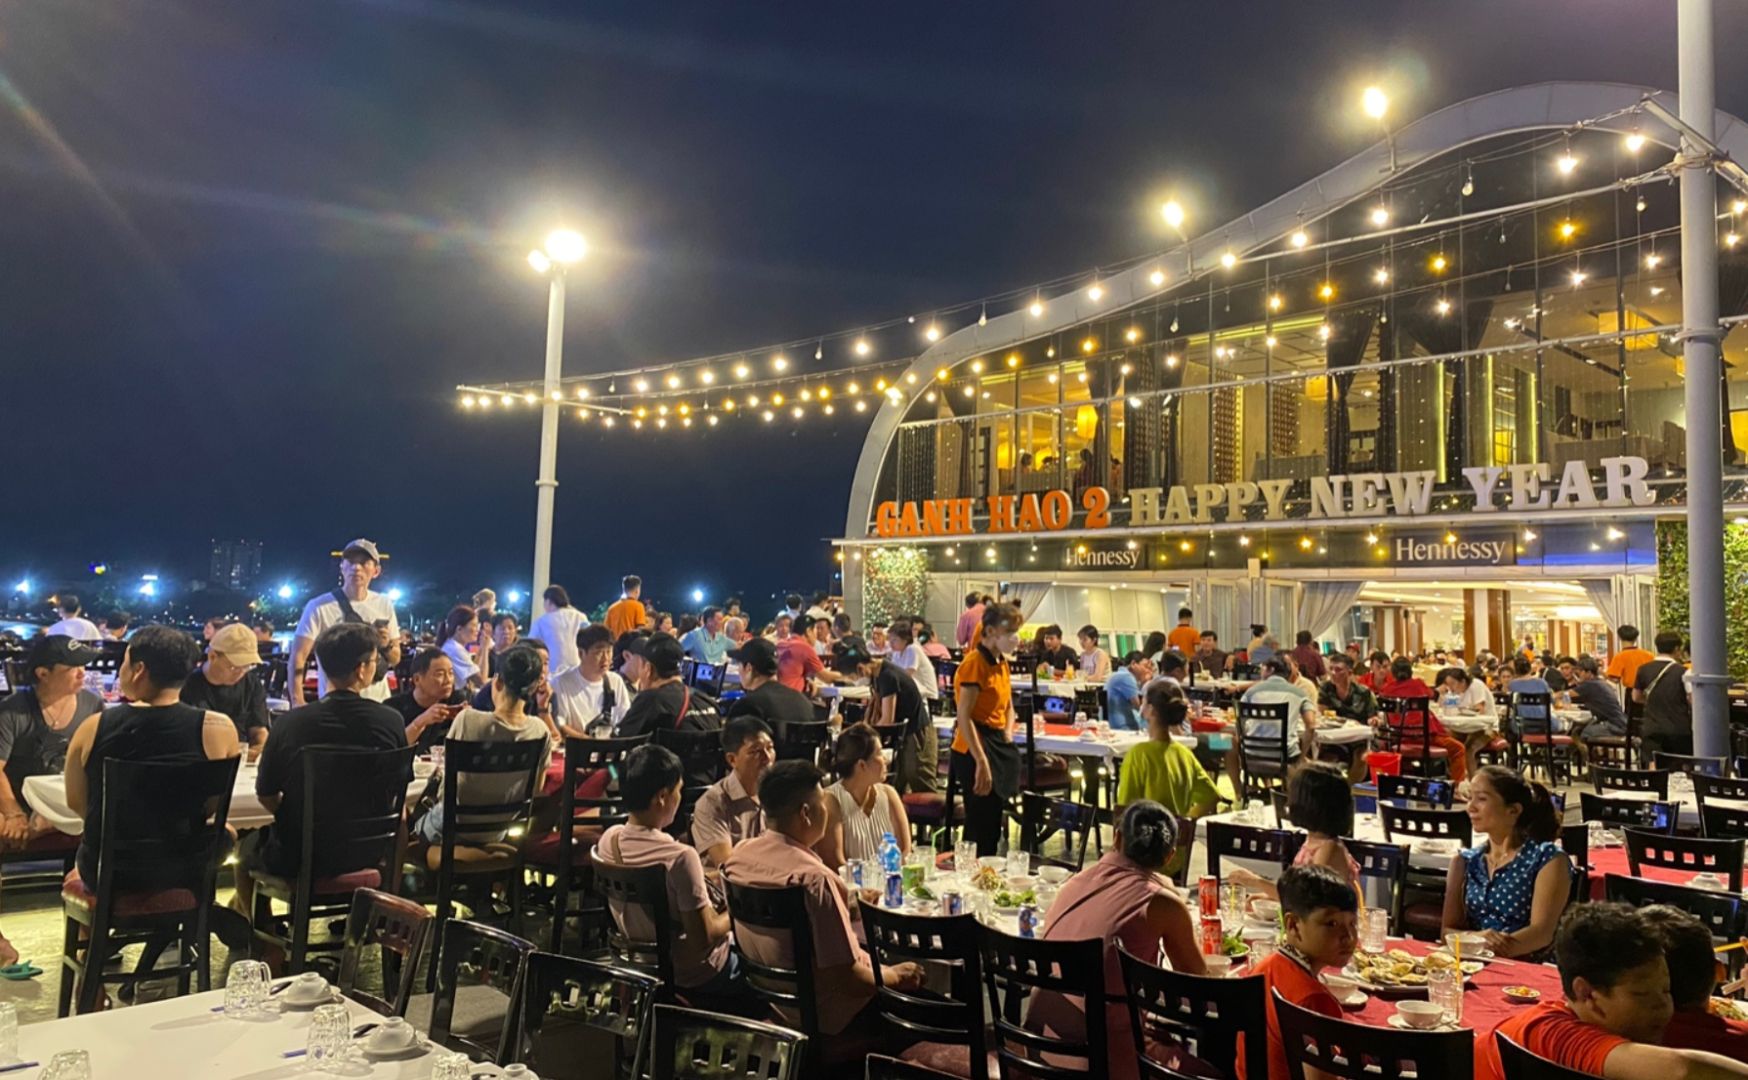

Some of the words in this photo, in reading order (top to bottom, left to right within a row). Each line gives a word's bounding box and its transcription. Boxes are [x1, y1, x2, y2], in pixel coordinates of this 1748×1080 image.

[1128, 479, 1294, 526] HAPPY
[1307, 470, 1436, 518] NEW
[1462, 455, 1657, 512] YEAR
[876, 498, 975, 537] GANH
[987, 490, 1073, 533] HAO
[1083, 486, 1112, 529] 2
[1066, 547, 1140, 569] Hennessy
[1396, 538, 1506, 564] Hennessy
